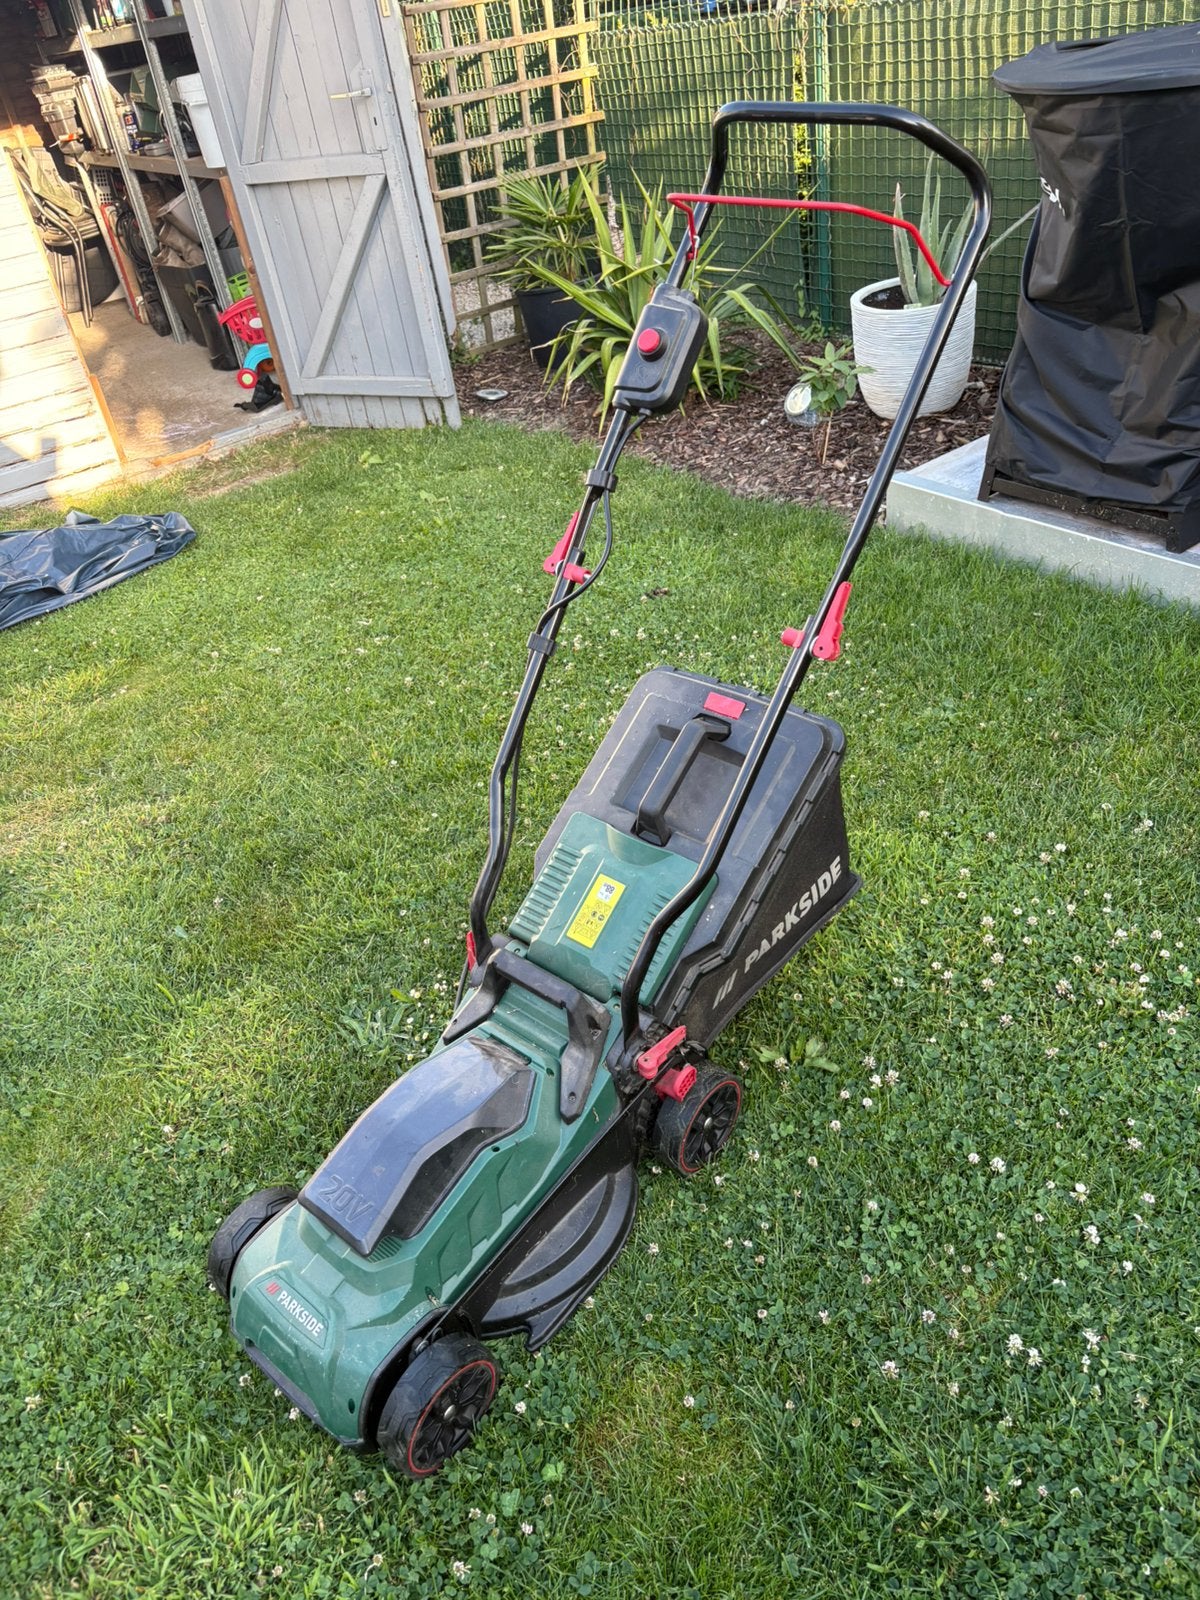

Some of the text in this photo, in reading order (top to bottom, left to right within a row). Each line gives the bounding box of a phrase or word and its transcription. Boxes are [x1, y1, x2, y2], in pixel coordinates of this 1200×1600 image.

[744, 855, 842, 974] PARKSIDE
[318, 1174, 374, 1222] 20V
[277, 1289, 325, 1337] PARKSIDE
